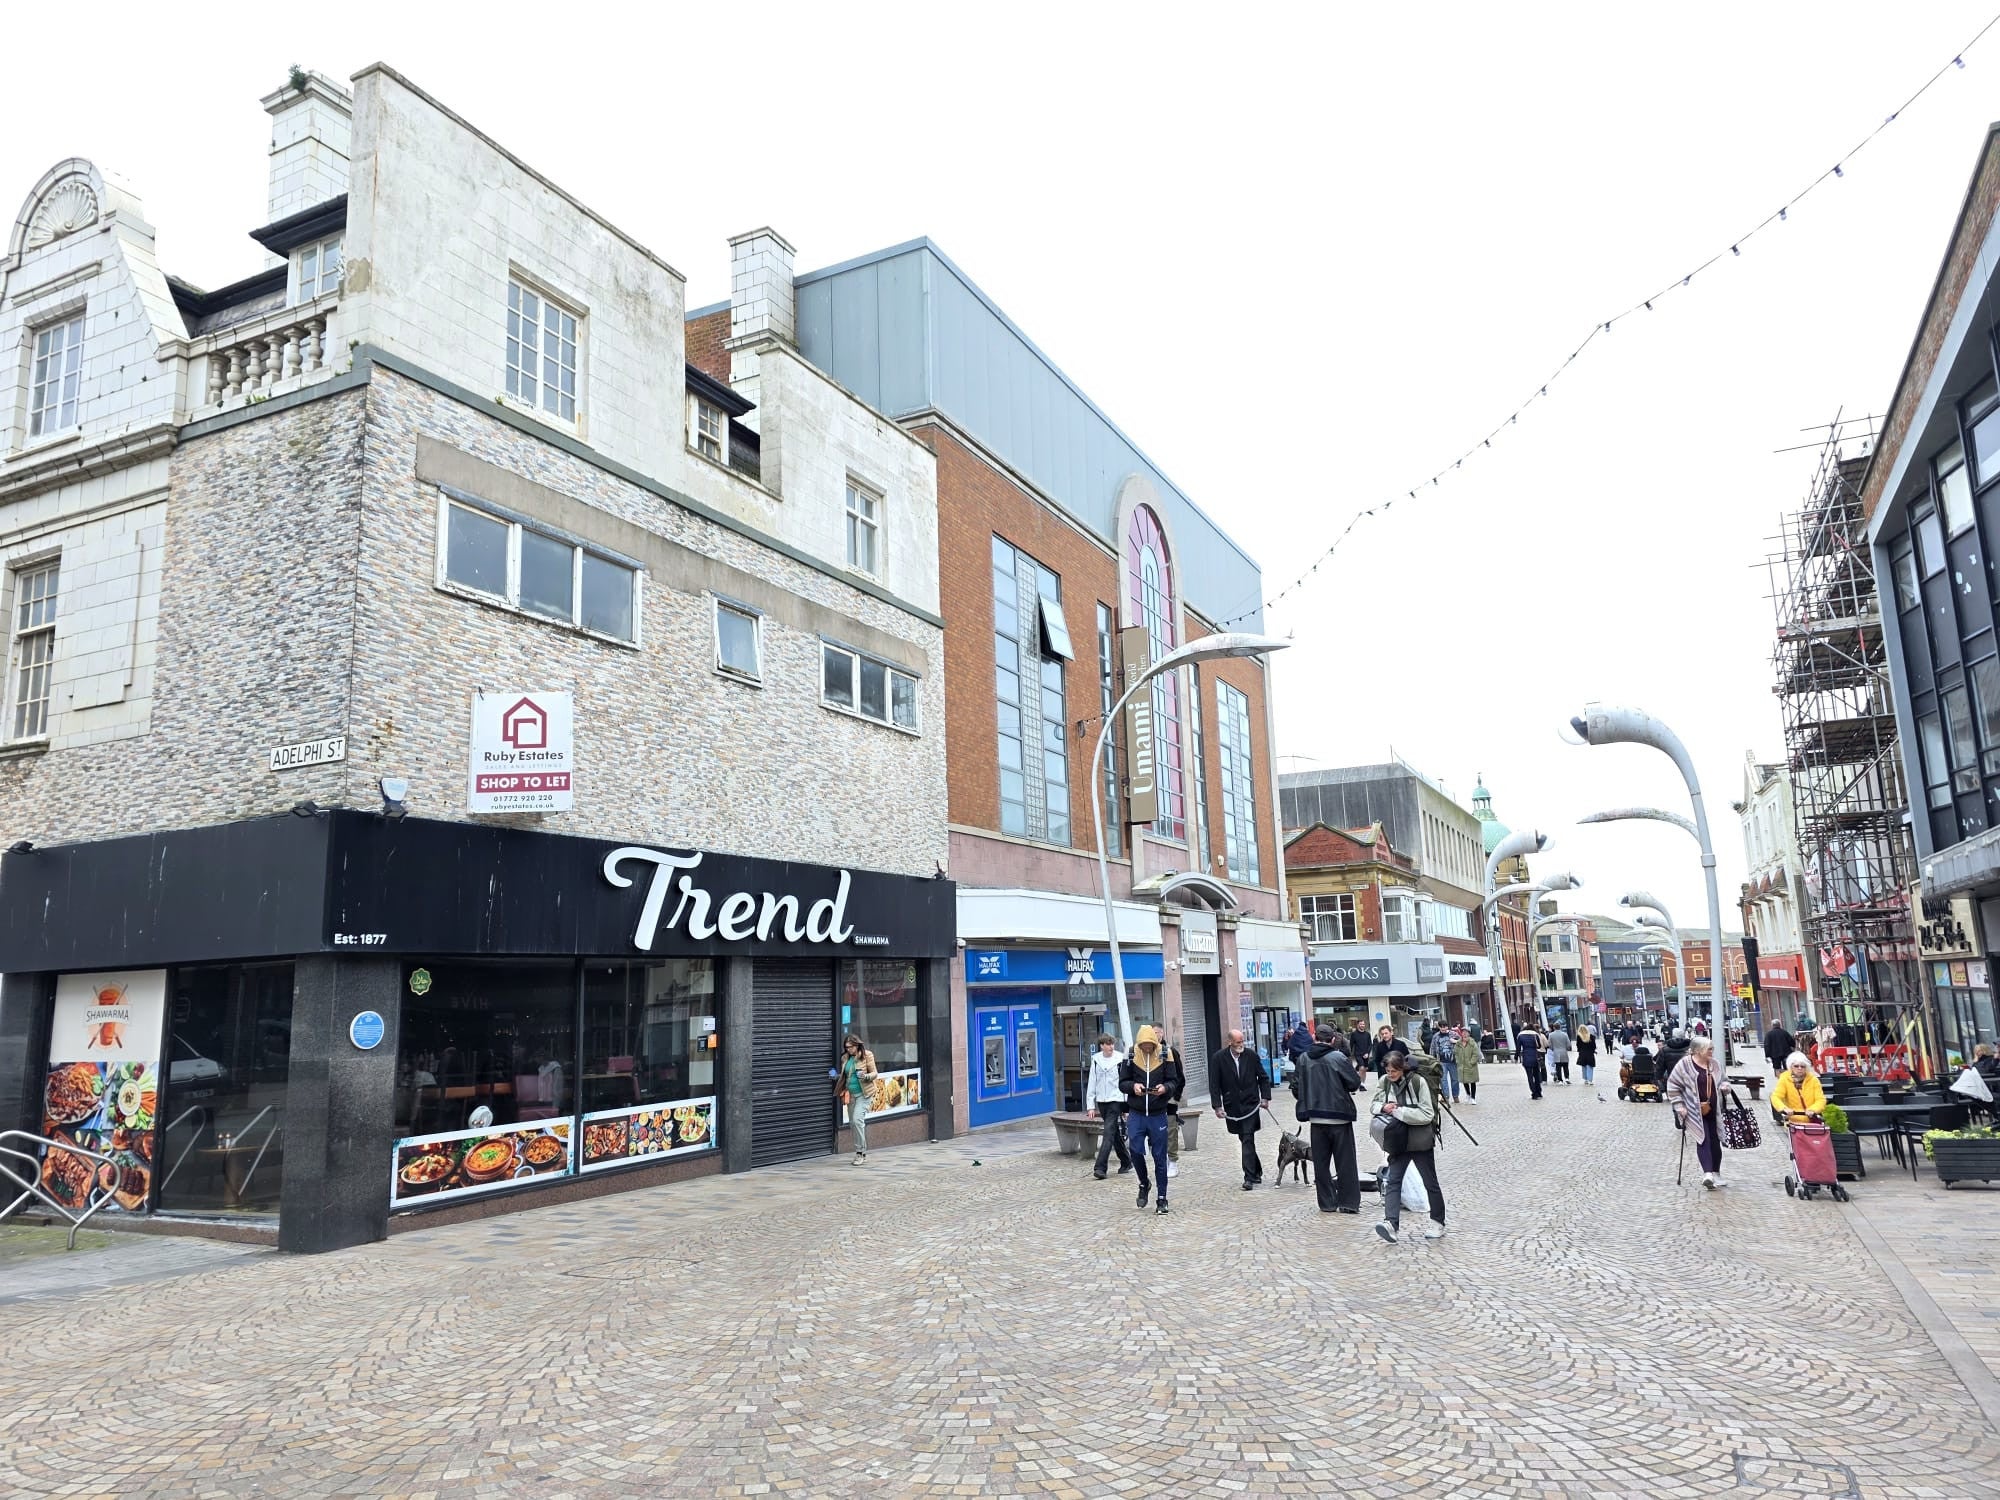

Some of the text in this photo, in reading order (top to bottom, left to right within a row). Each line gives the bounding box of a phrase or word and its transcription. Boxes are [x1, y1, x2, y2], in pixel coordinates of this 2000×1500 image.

[1128, 702, 1153, 794] Umami
[272, 746, 323, 768] ADELPHI
[484, 751, 564, 763] Ruby Estates
[481, 776, 567, 789] SHOP TO LET
[491, 802, 554, 810] rubyestates.co.uk
[603, 846, 855, 951] Trend
[334, 933, 387, 945] Est: 1877
[855, 935, 889, 945] SHAWARMA
[1067, 959, 1095, 972] HALIFAX
[1311, 966, 1379, 981] BROOKS
[86, 1009, 129, 1022] SHAWARMA
